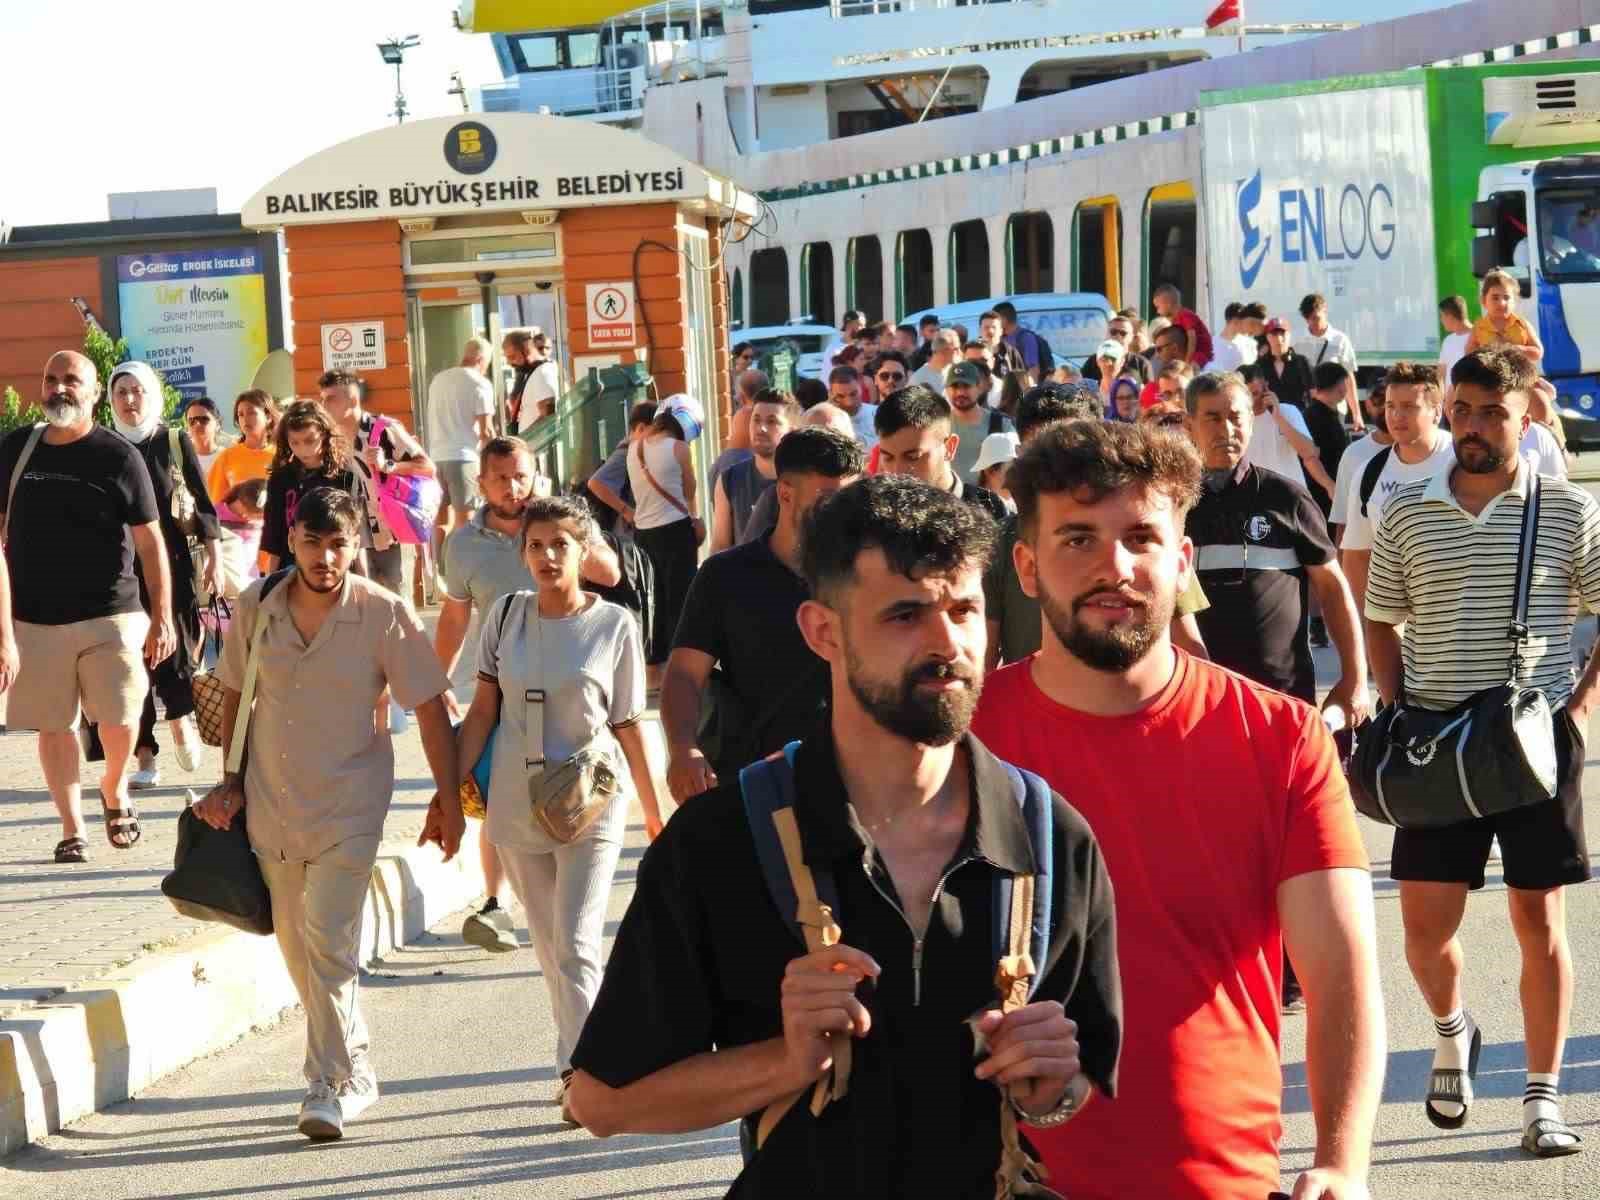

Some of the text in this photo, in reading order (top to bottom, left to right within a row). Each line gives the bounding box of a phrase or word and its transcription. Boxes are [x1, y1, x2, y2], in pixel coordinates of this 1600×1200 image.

[266, 167, 684, 215] BALIKESİR BÜYÜKŞEHİR BELEDİYESİ
[1279, 183, 1396, 263] ENLOG
[182, 260, 213, 272] ERDEK
[214, 256, 255, 269] İSKELESİ
[593, 327, 631, 338] YAYA YOLU
[145, 345, 194, 359] ERDEK'ten
[171, 355, 192, 367] GÜN
